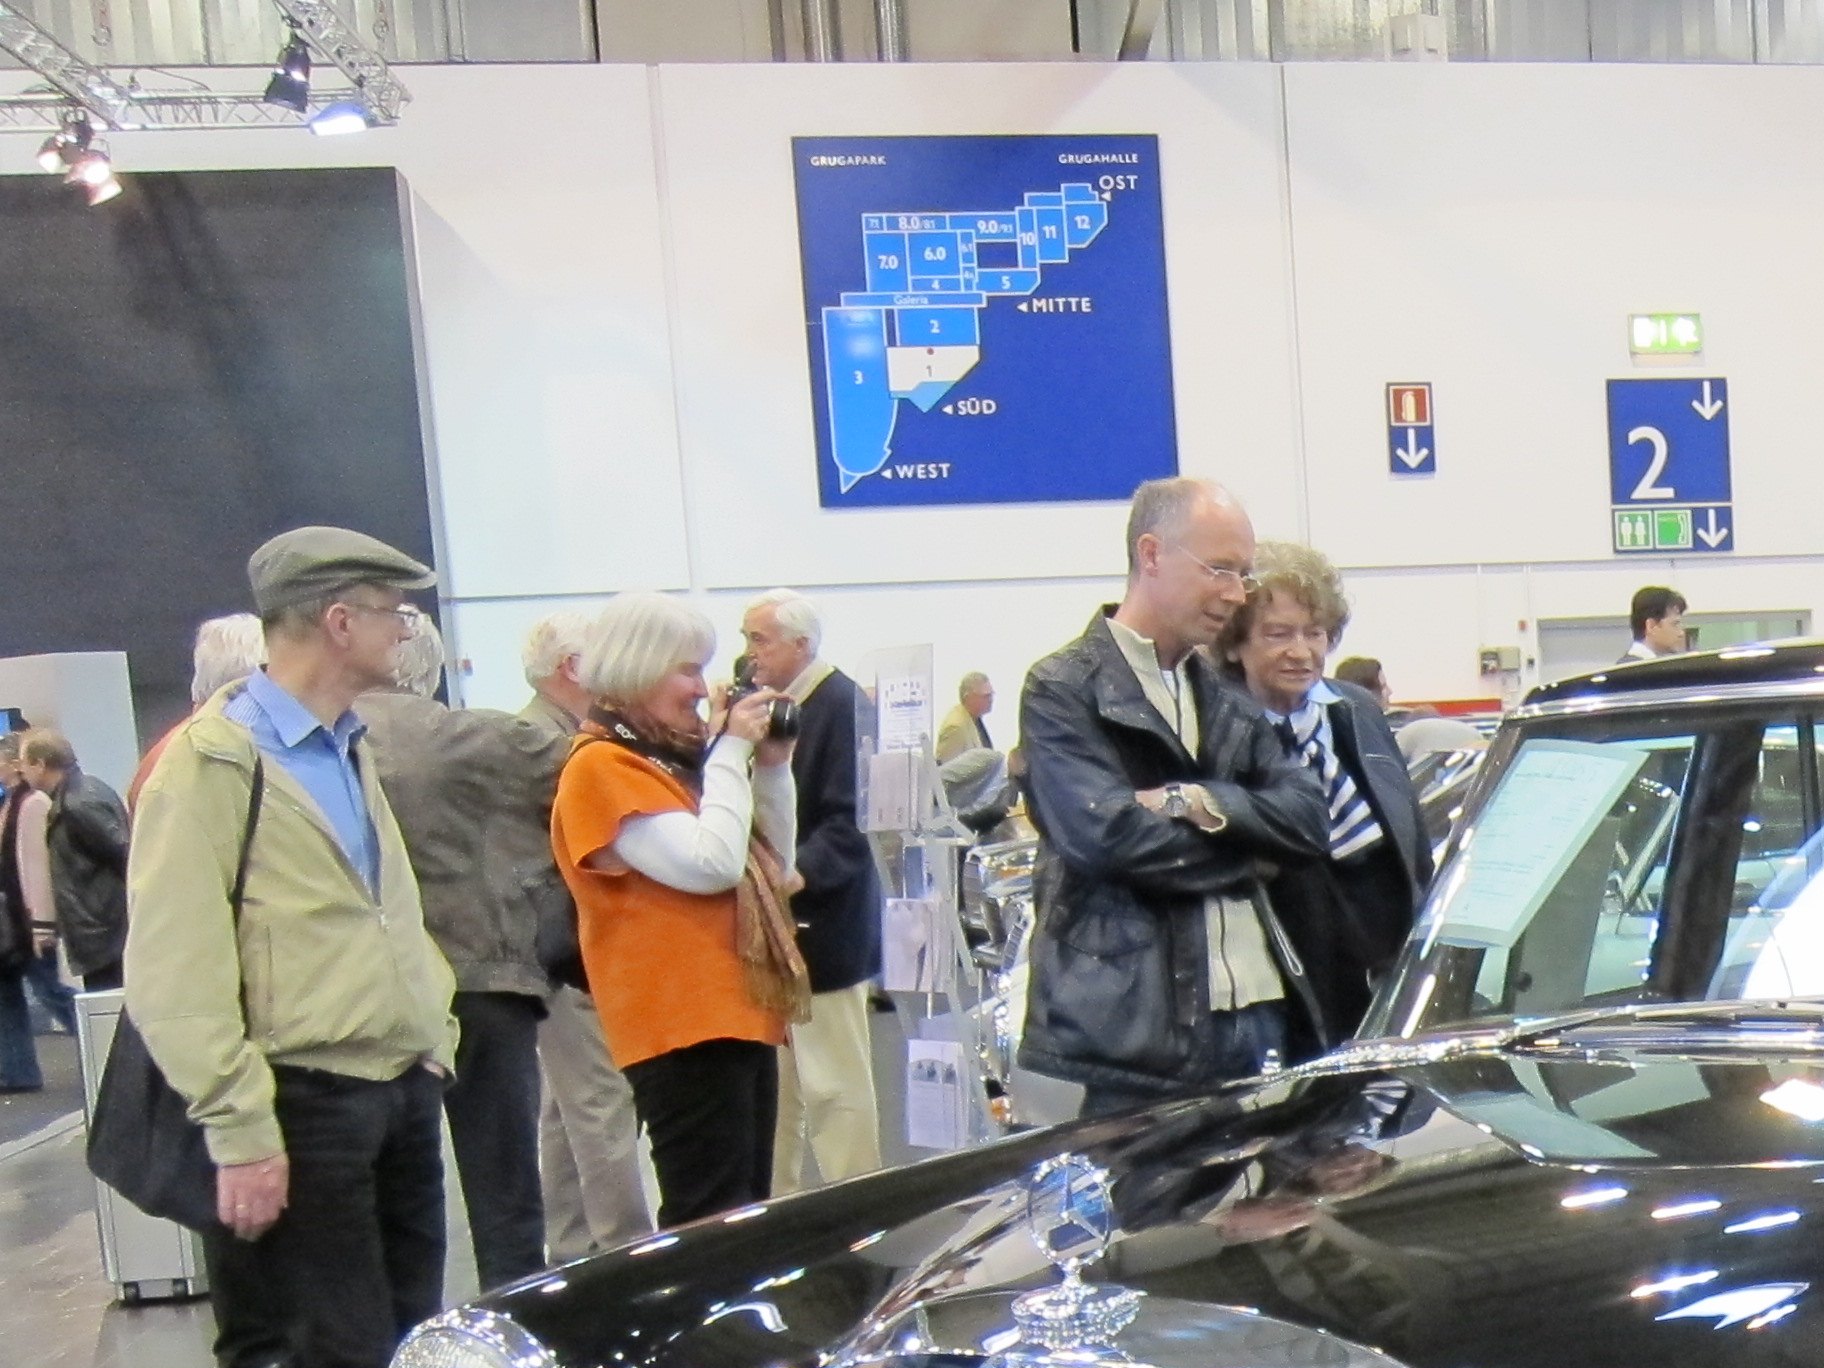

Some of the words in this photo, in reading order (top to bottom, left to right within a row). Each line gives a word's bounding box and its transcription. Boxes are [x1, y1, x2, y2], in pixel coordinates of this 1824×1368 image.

[810, 155, 887, 167] GRUGAPARK
[1058, 153, 1139, 164] GRUGAHALLE
[1099, 175, 1138, 190] OST
[1074, 215, 1091, 229] 12
[1020, 232, 1035, 246] 10
[1042, 225, 1057, 239] 11
[924, 246, 947, 261] 6.0
[878, 254, 899, 270] 7.0
[931, 279, 940, 290] 4
[1001, 275, 1011, 289] 5
[1032, 297, 1092, 313] MITTE
[929, 319, 940, 334] 2
[854, 370, 864, 385] 3
[926, 365, 933, 378] 1
[957, 399, 997, 415] SÜD
[1627, 426, 1675, 499] 2
[895, 463, 950, 479] WEST
